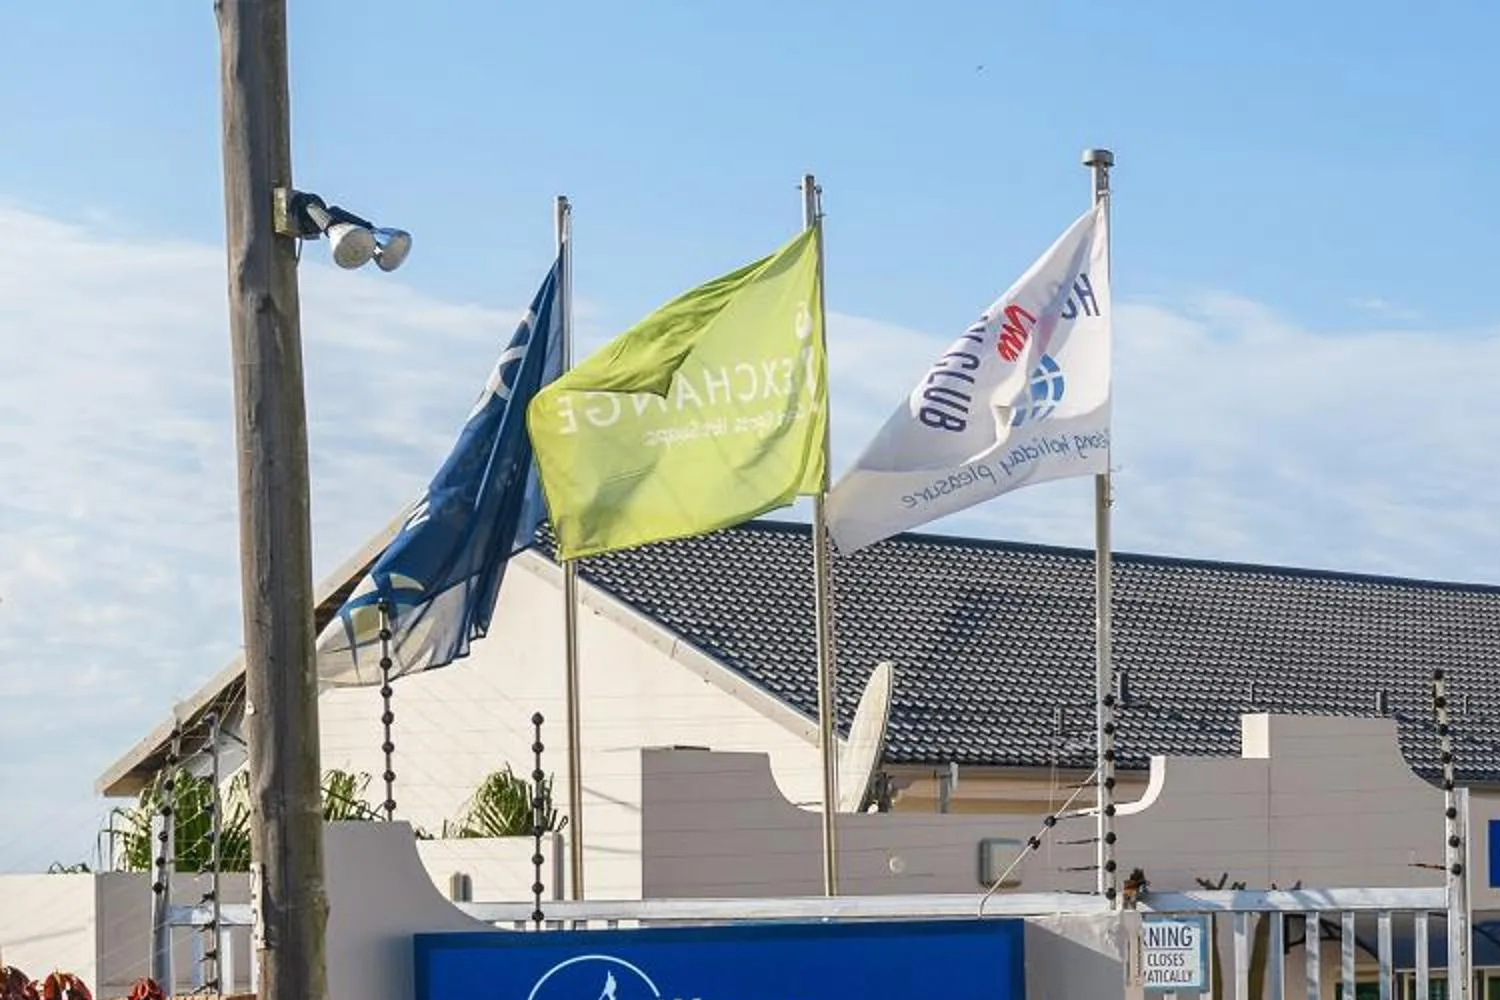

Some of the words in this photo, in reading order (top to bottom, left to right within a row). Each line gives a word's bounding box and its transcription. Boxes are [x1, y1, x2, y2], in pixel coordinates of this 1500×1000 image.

[1144, 925, 1193, 947] NING
[1147, 952, 1185, 967] CLOSES
[1143, 969, 1193, 983] ATICALLY
